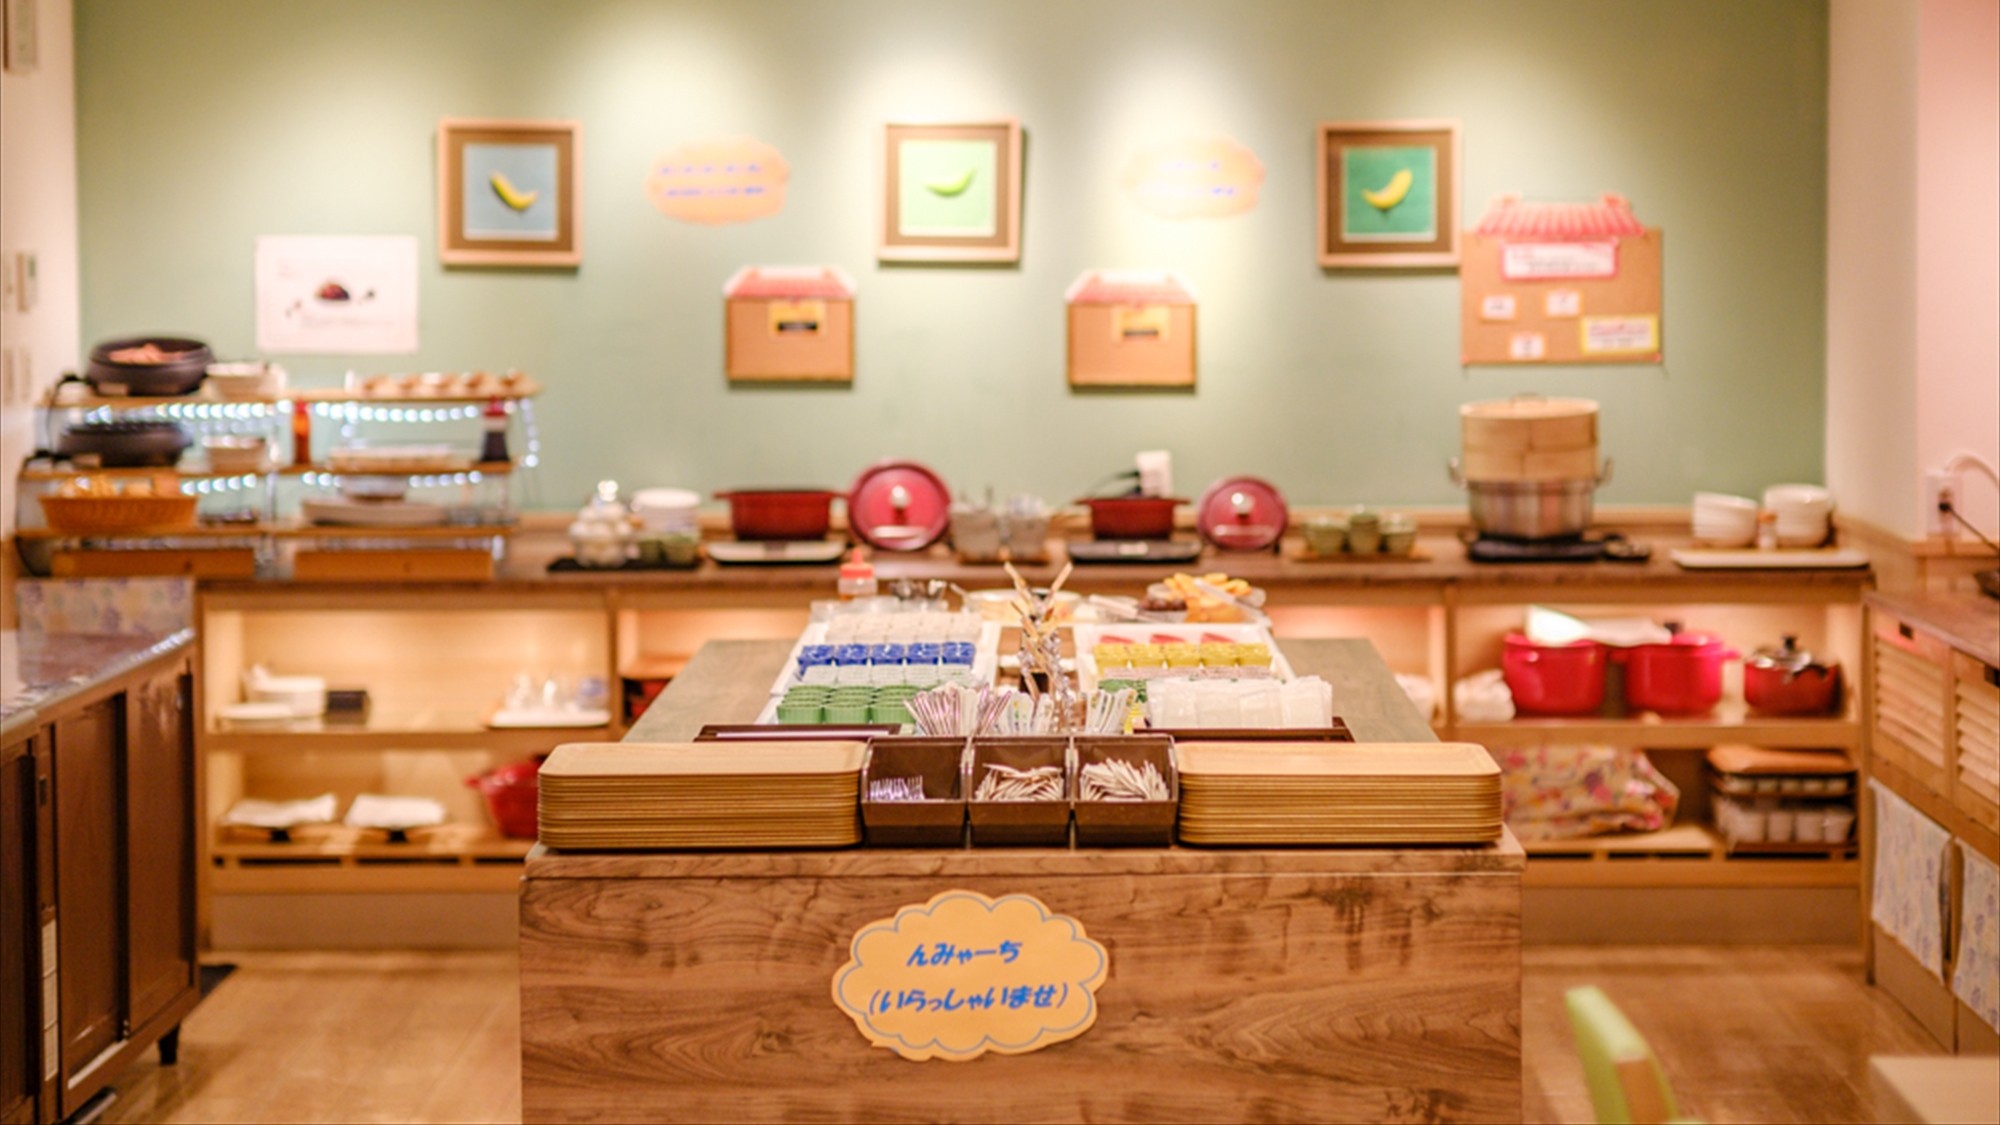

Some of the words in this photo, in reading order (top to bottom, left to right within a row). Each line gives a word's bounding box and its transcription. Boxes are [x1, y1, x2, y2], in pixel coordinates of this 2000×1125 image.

[906, 940, 1023, 967] んみゃーち
[869, 982, 1068, 1016] (いらっしゃいませ)
